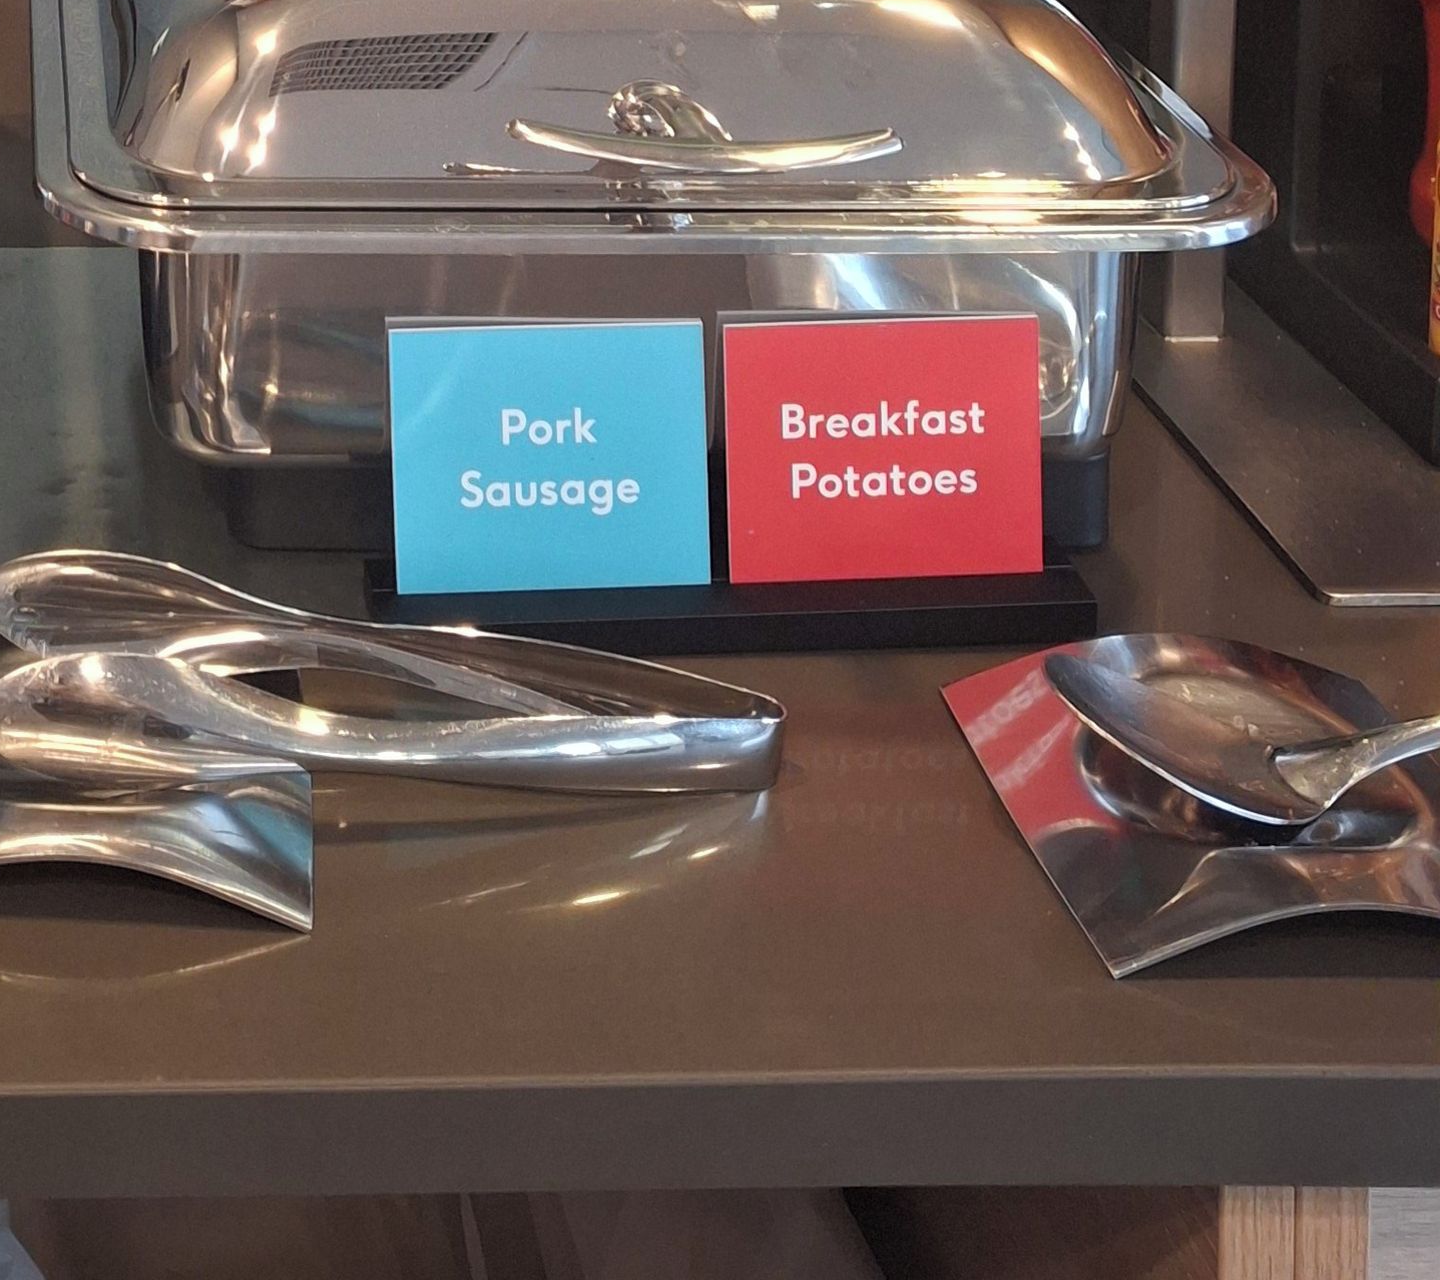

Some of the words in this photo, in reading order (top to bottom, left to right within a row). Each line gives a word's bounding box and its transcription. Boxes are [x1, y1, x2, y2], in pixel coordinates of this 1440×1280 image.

[500, 406, 598, 446] Pork
[780, 398, 986, 441] Breakfast
[459, 469, 641, 517] Sausage
[790, 461, 979, 500] Potatoes
